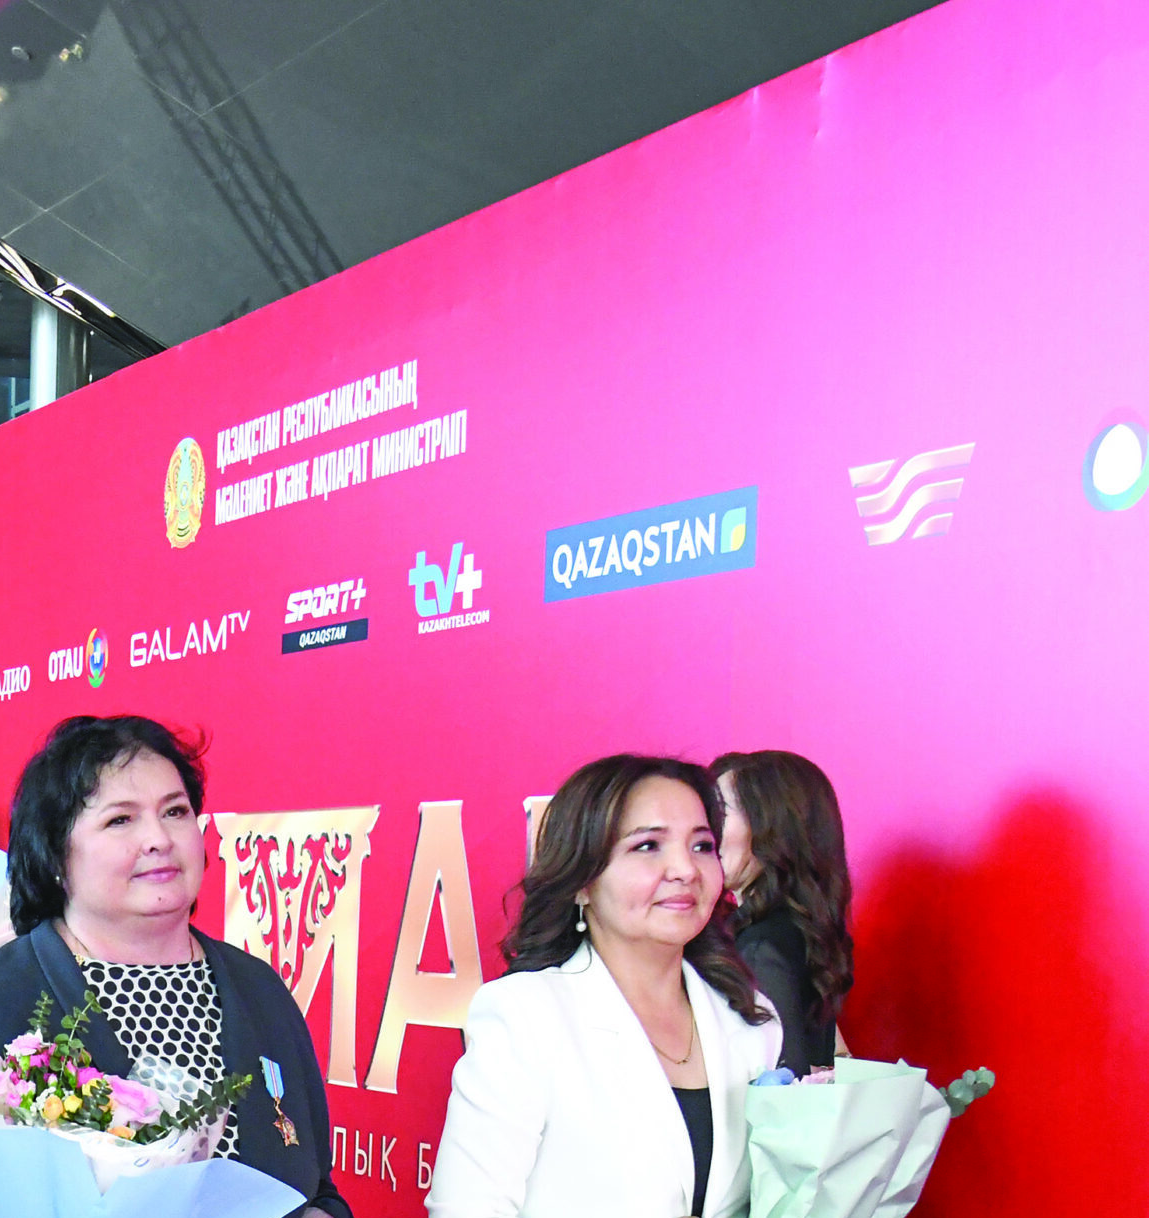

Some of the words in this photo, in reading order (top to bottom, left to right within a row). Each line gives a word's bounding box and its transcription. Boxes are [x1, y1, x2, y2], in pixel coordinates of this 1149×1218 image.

[216, 410, 281, 474] ҚАЗАҚСТАН
[282, 359, 418, 446] РЕСПУБЛИКАСЫНЫҢ
[214, 471, 273, 526] МӘДЕНИЕТ
[274, 459, 310, 508] ЖӘНЕ
[310, 440, 370, 501] АҚПАРАТ
[552, 512, 716, 589] QAZAQSTAN
[284, 578, 367, 624] SPORT+
[418, 610, 491, 634] KAZAKHTELECOM
[48, 646, 84, 682] OTAU
[299, 625, 347, 648] QAZAQSTAN
[332, 1126, 397, 1192] ЛЫҚ
[417, 1142, 433, 1190] Б
